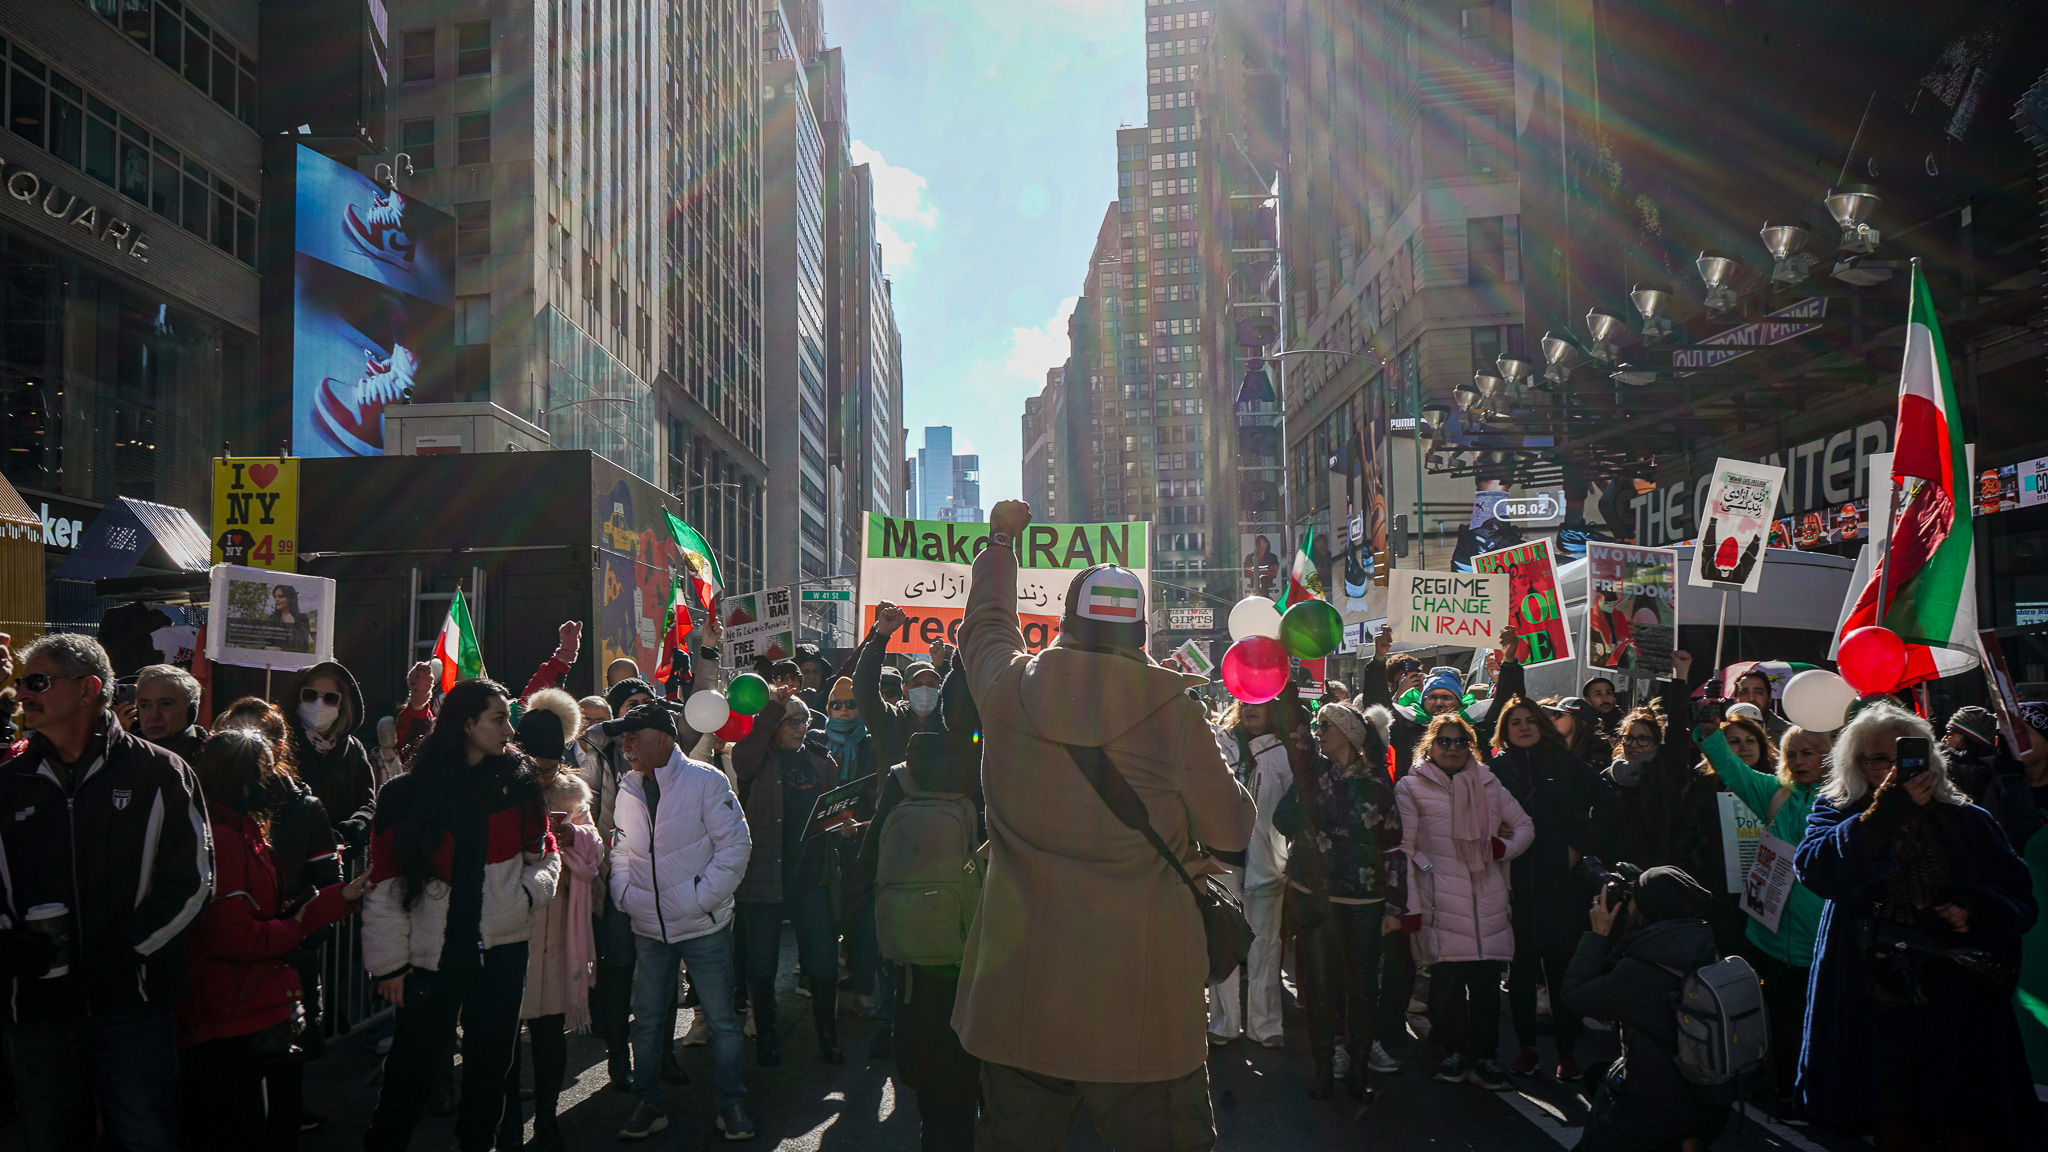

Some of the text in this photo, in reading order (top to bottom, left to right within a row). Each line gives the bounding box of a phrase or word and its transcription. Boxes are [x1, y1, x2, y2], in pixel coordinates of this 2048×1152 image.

[0, 157, 155, 263] QUARE
[1390, 417, 1415, 427] PUMA
[230, 463, 245, 490] I
[226, 492, 280, 525] NY
[1505, 503, 1547, 516] MB.02
[1629, 482, 1685, 547] THE
[226, 534, 233, 546] I
[1016, 525, 1129, 568] IRAN
[225, 546, 243, 556] NY
[1503, 542, 1550, 569] OUR
[1591, 547, 1672, 566] WOMAN
[812, 592, 840, 600] W 41 St
[1411, 576, 1490, 598] REGIME
[1592, 578, 1673, 600] FREEDOM
[767, 591, 789, 605] FREE
[1412, 595, 1491, 615] CHANGE
[769, 603, 789, 618] IRAN
[1170, 615, 1213, 624] GIFTS
[1410, 615, 1491, 637] IN IRAN
[734, 640, 754, 655] FREE
[735, 653, 754, 669] IRAN
